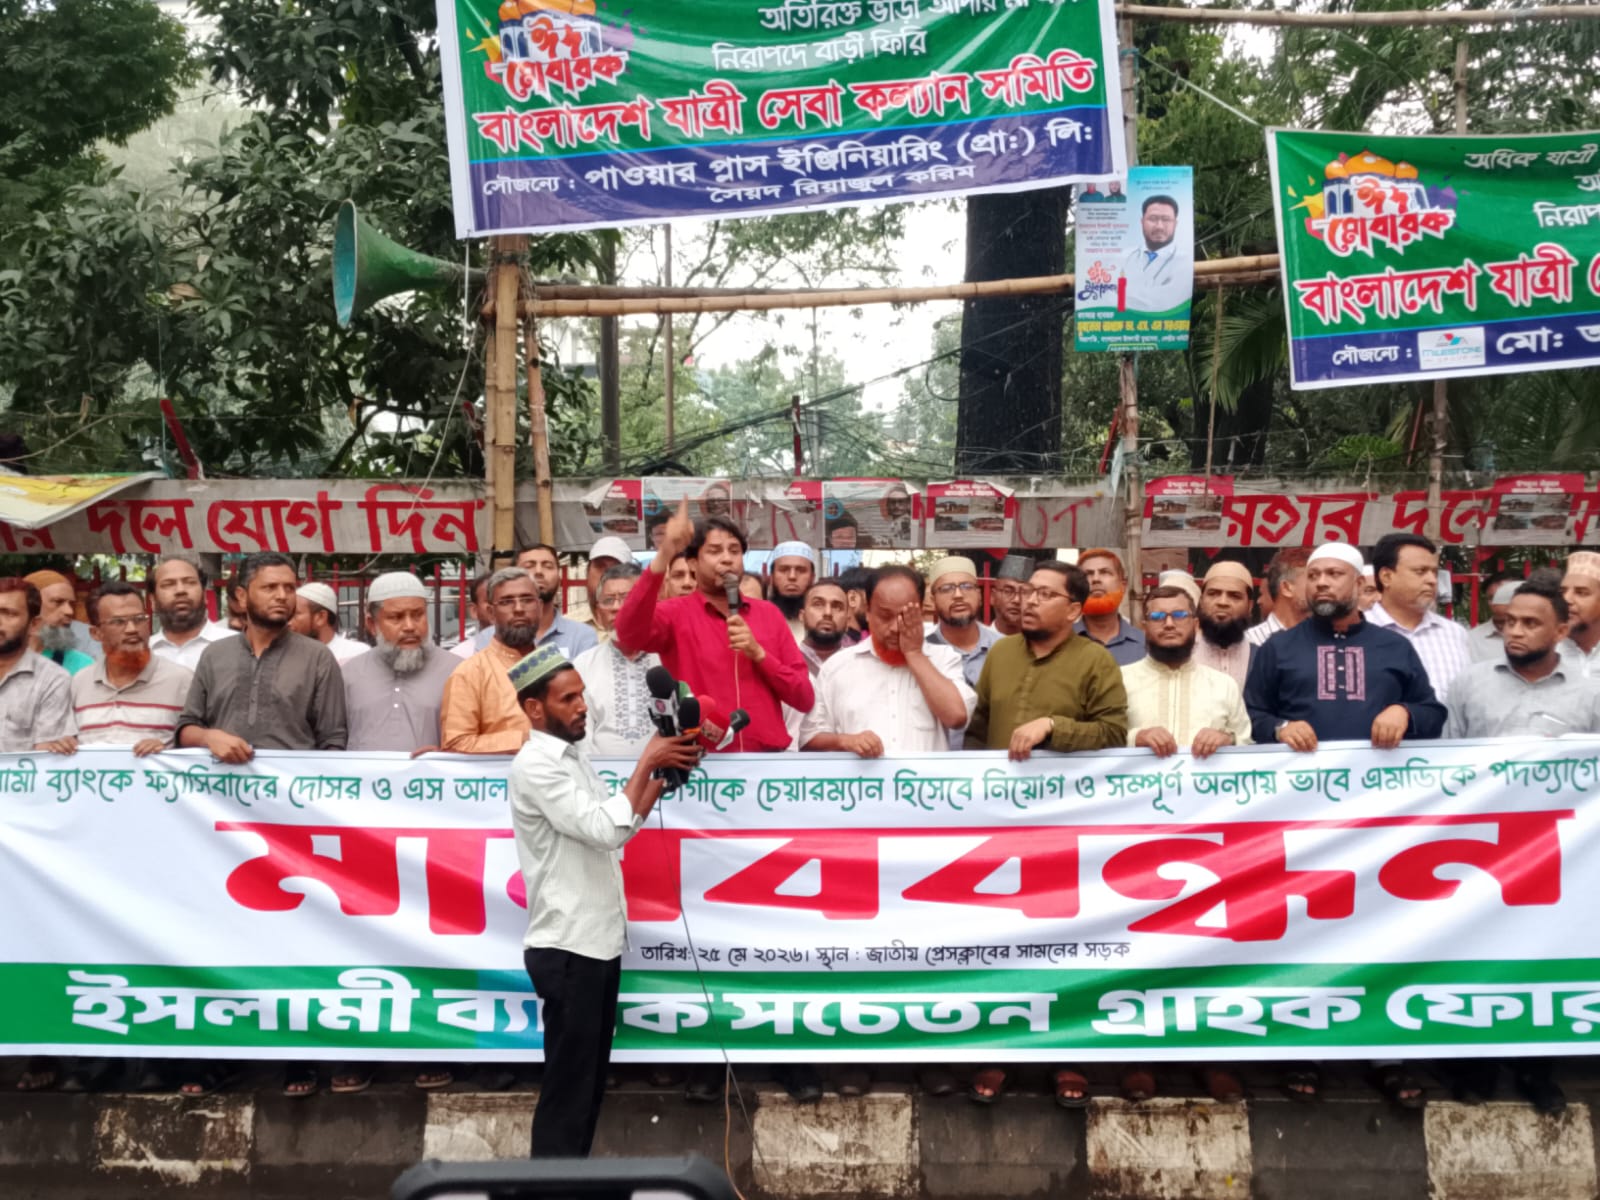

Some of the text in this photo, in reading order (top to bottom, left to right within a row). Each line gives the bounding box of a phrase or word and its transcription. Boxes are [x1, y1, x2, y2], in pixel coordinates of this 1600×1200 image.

[712, 25, 927, 72] নিরাপদে বাড়ী ফিরি
[473, 49, 1098, 153] বাংলাদেশ যাত্রী সেবা কল্যান সমিতি
[491, 50, 629, 101] মোবারক
[482, 174, 560, 196] সৌজন্যে
[584, 161, 698, 191] পাওয়ার
[709, 153, 770, 183] প্লাস
[778, 134, 948, 176] ইঞ্জিনিয়ারিং
[905, 164, 977, 185] করিম
[1464, 143, 1598, 169] অধিক যাত্রী
[1312, 207, 1456, 257] মোবারক
[1294, 259, 1482, 326] বাংলাদেশ
[1483, 241, 1579, 308] যাত্রী
[1332, 345, 1400, 367] সৌজন্যে
[207, 490, 342, 553] যোগ
[358, 483, 486, 552] দিন
[46, 768, 135, 802] ব্যাংকে
[143, 764, 280, 807] ফ্যাসিবাদের
[288, 776, 363, 808] দোসর
[371, 778, 393, 801] ও
[403, 778, 444, 802] এস
[757, 776, 884, 811] চেয়ারম্যান
[894, 768, 973, 811] হিসেবে
[983, 768, 1065, 810] নিয়োগ
[1075, 779, 1096, 799] ও
[1106, 760, 1184, 814] সম্পূর্ণ
[1192, 770, 1277, 805] অন্যায়
[1286, 766, 1351, 802] ভাবে
[1361, 757, 1478, 796] এমডিকে
[698, 947, 721, 962] ২৫
[728, 947, 747, 967] মে
[815, 947, 850, 970] স্থান
[865, 939, 919, 963] জাতীয়
[925, 944, 1010, 966] প্রেসক্লাবের
[1015, 942, 1078, 964] সামনের
[1084, 942, 1131, 961] সড়ক
[66, 968, 421, 1036] ইসলামী
[721, 991, 1058, 1035] সচেতন
[1091, 986, 1365, 1037] গ্রাহক
